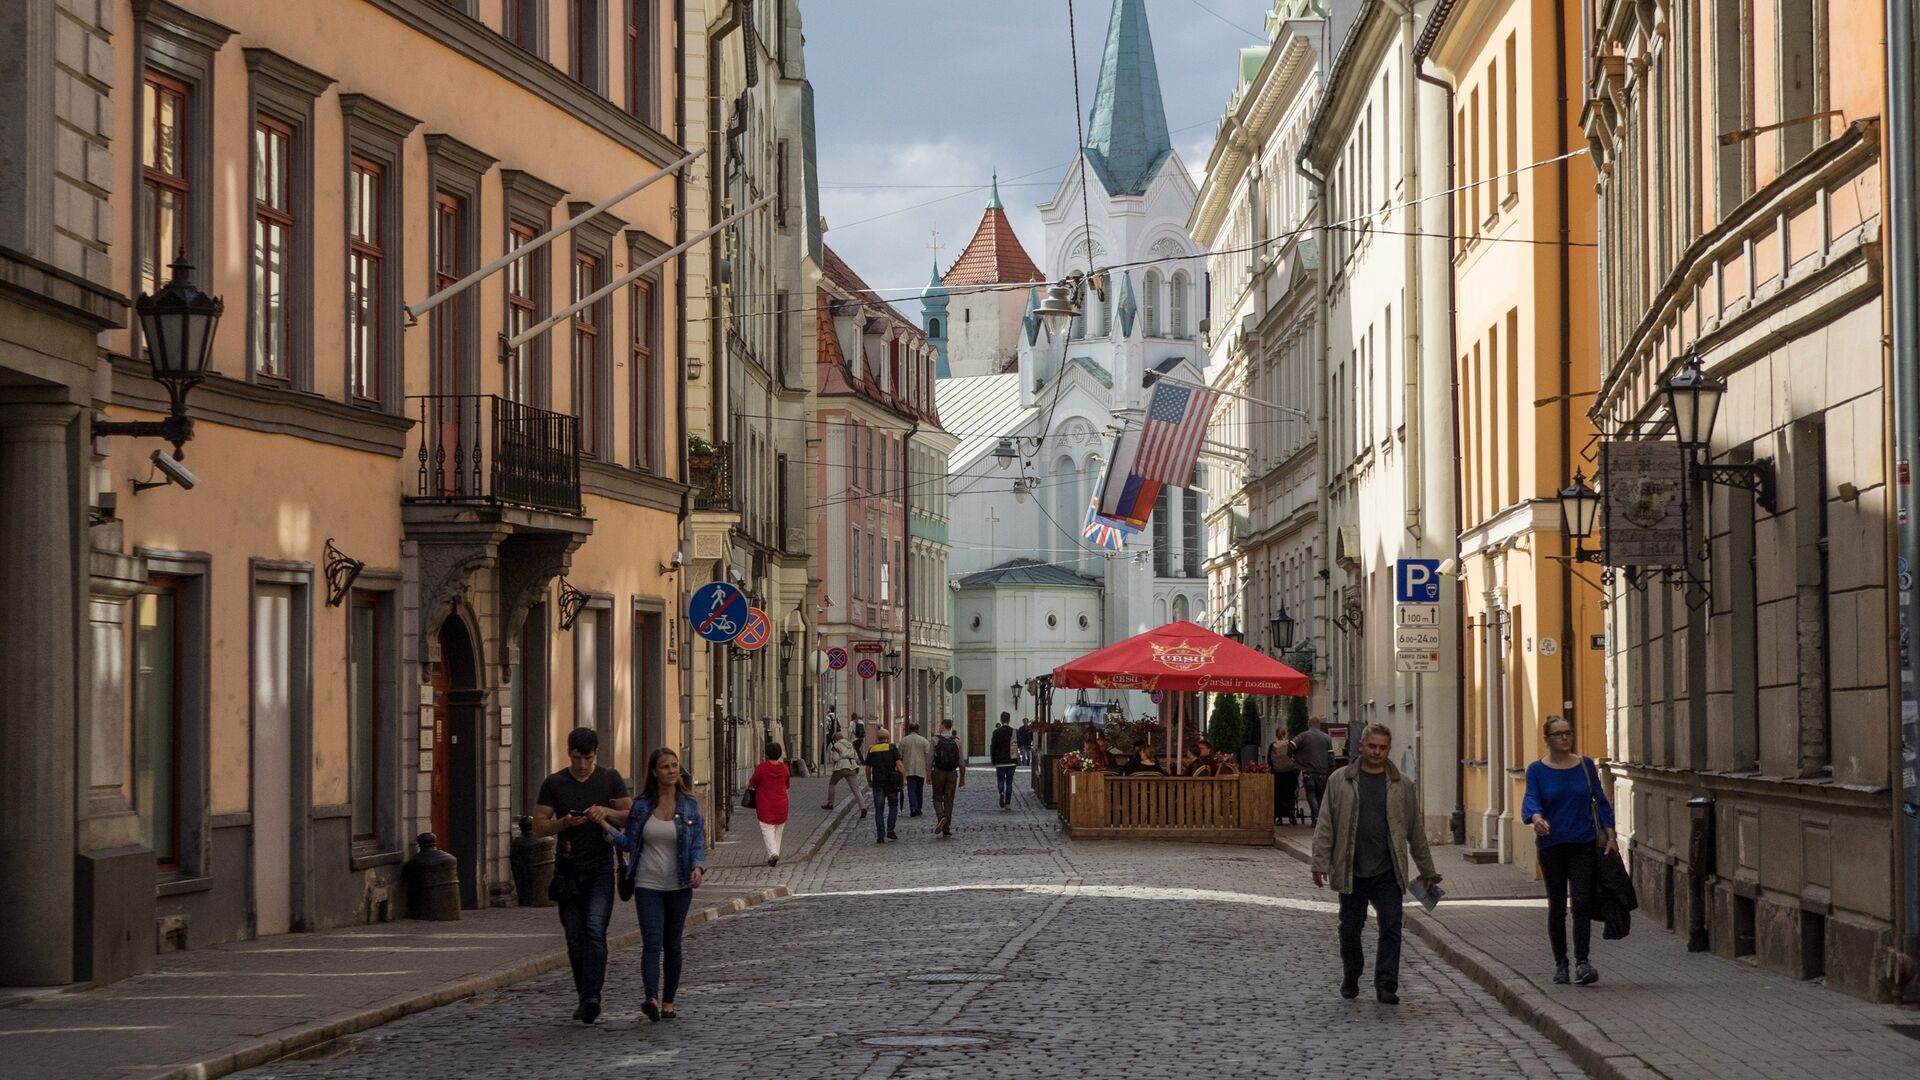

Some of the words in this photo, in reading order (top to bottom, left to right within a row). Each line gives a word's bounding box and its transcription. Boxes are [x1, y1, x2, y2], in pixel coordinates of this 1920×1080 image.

[1406, 564, 1430, 597] P
[1407, 614, 1421, 622] 100
[1235, 678, 1243, 687] ir
